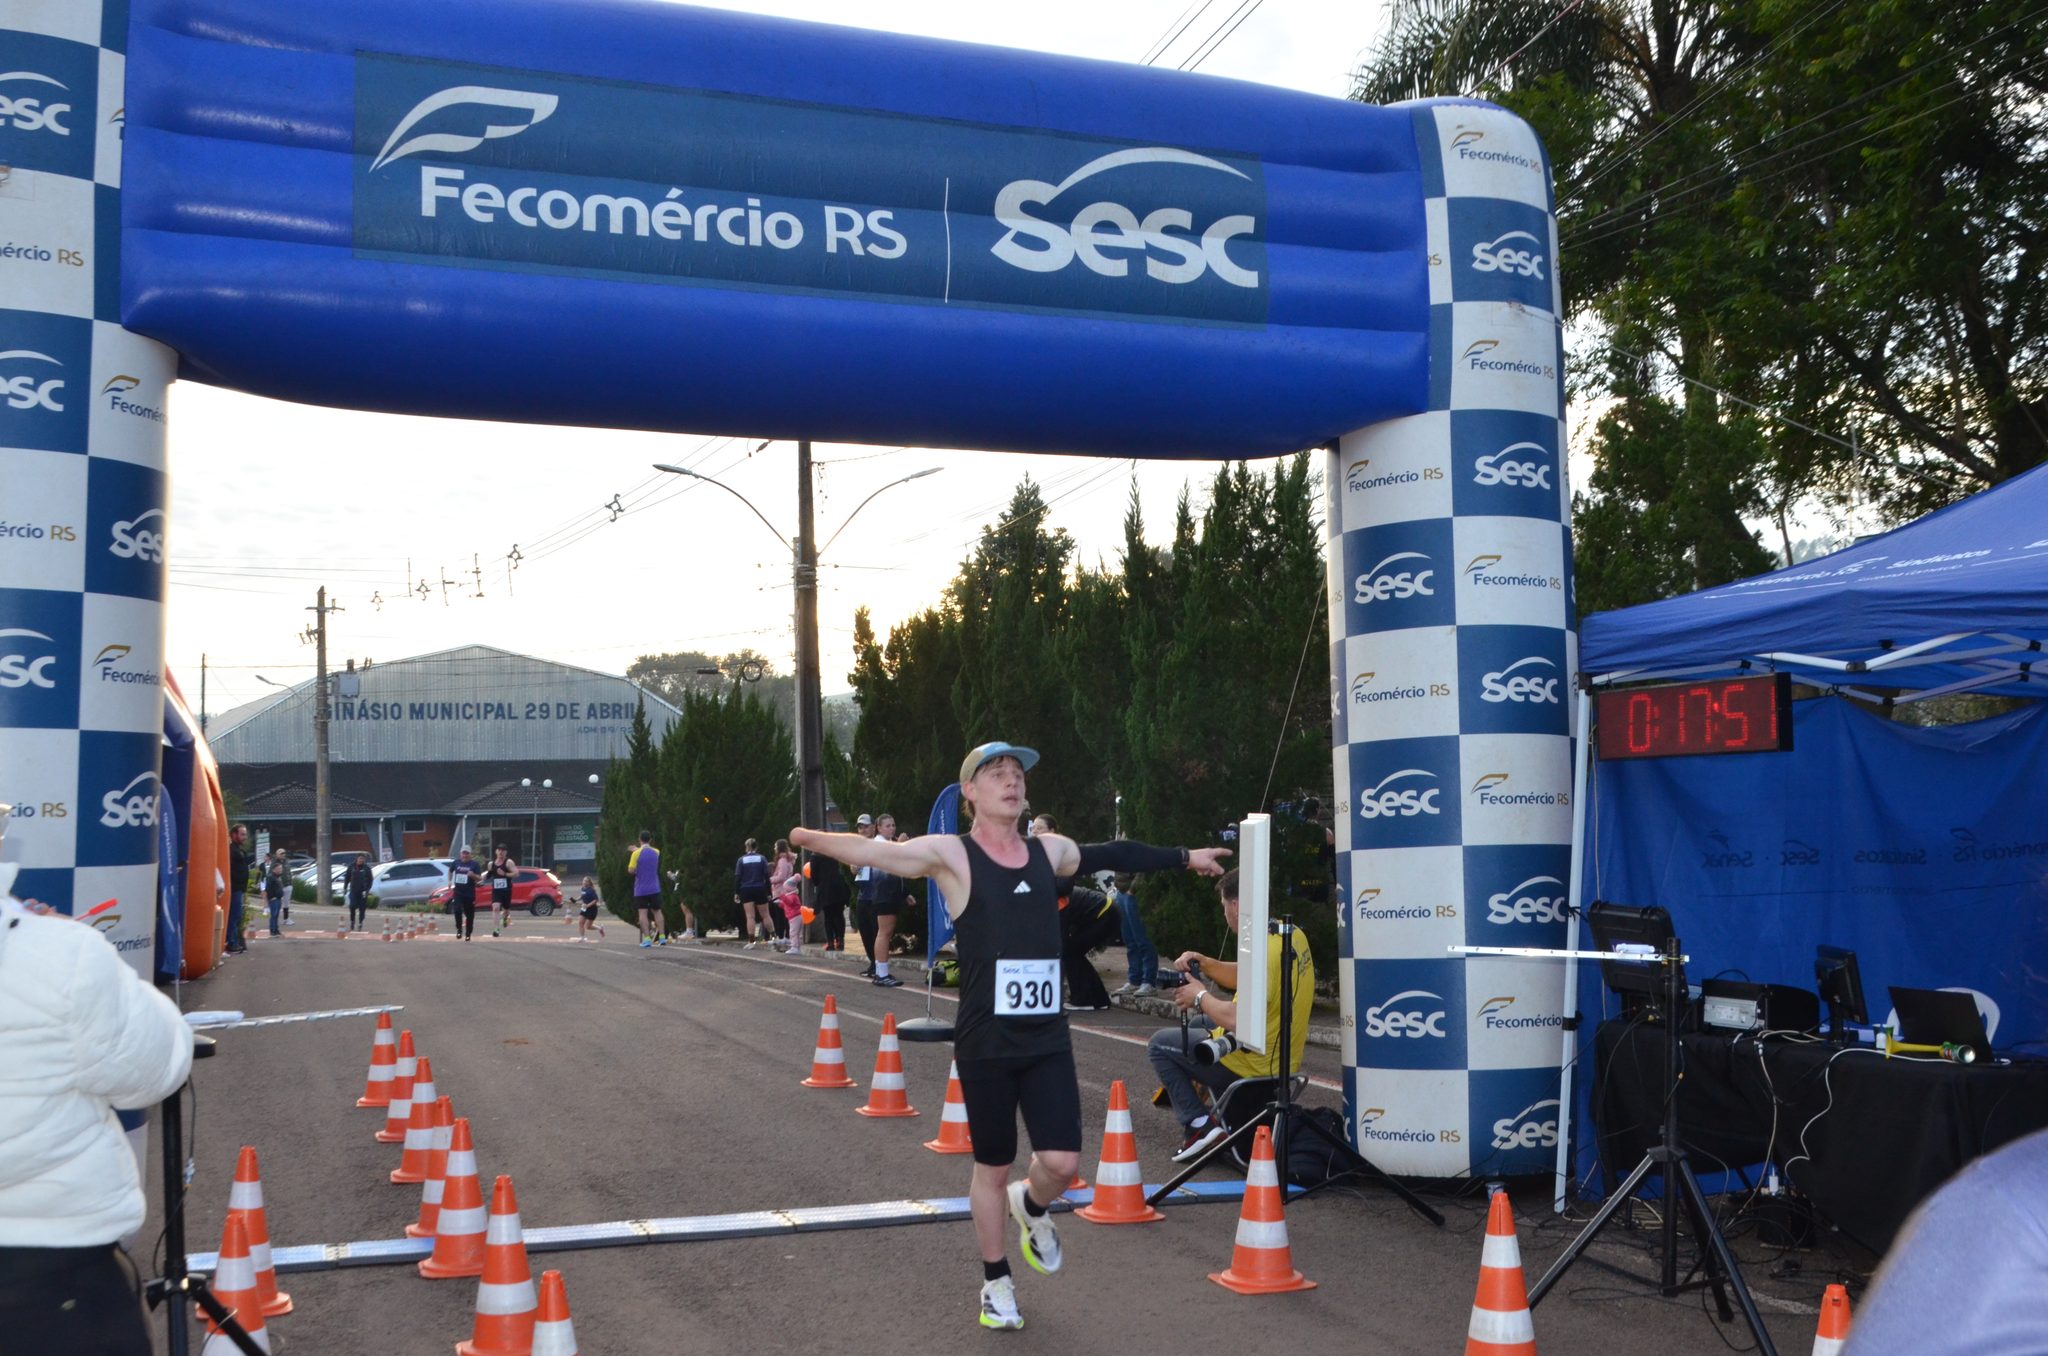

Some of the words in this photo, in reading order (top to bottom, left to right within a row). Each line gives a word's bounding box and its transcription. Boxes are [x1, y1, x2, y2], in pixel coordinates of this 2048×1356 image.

[1460, 148, 1529, 168] Fecomércio
[1529, 158, 1541, 174] RS
[420, 165, 803, 249] Fecomércio
[826, 205, 907, 260] RS
[990, 178, 1259, 288] Sesc
[0, 242, 51, 261] ércio
[58, 248, 84, 266] RS
[1472, 242, 1544, 280] Sesc
[1470, 358, 1542, 376] Fecomércio
[1543, 365, 1554, 380] RS
[1350, 470, 1419, 492] Fecomércio
[1423, 467, 1444, 480] RS
[1473, 456, 1550, 490] Sesc
[0, 521, 44, 539] ércio
[50, 525, 76, 541] RS
[109, 520, 164, 564] Ses
[1354, 569, 1434, 604] Sesc
[1474, 572, 1547, 588] Fecomércio
[1550, 577, 1562, 590] RS
[0, 655, 56, 688] sc
[1355, 686, 1425, 704] Fecomércio
[1430, 684, 1450, 697] RS
[1480, 671, 1558, 704] Sesc
[409, 702, 518, 720] MUNICIPAL
[525, 703, 550, 720] 29
[556, 702, 580, 720] DE
[42, 803, 67, 818] RS
[1360, 788, 1440, 819] Sesc
[1480, 792, 1555, 806] Fecomércio
[1557, 793, 1569, 806] RS
[1360, 905, 1432, 920] Fecomércio
[1436, 905, 1457, 918] RS
[1486, 893, 1567, 925] Sesc
[1006, 980, 1053, 1009] 930
[1365, 1007, 1446, 1038] Sesc
[1486, 1013, 1562, 1029] Fecomércio
[1365, 1126, 1436, 1143] Fecomércio
[1440, 1130, 1461, 1143] RS
